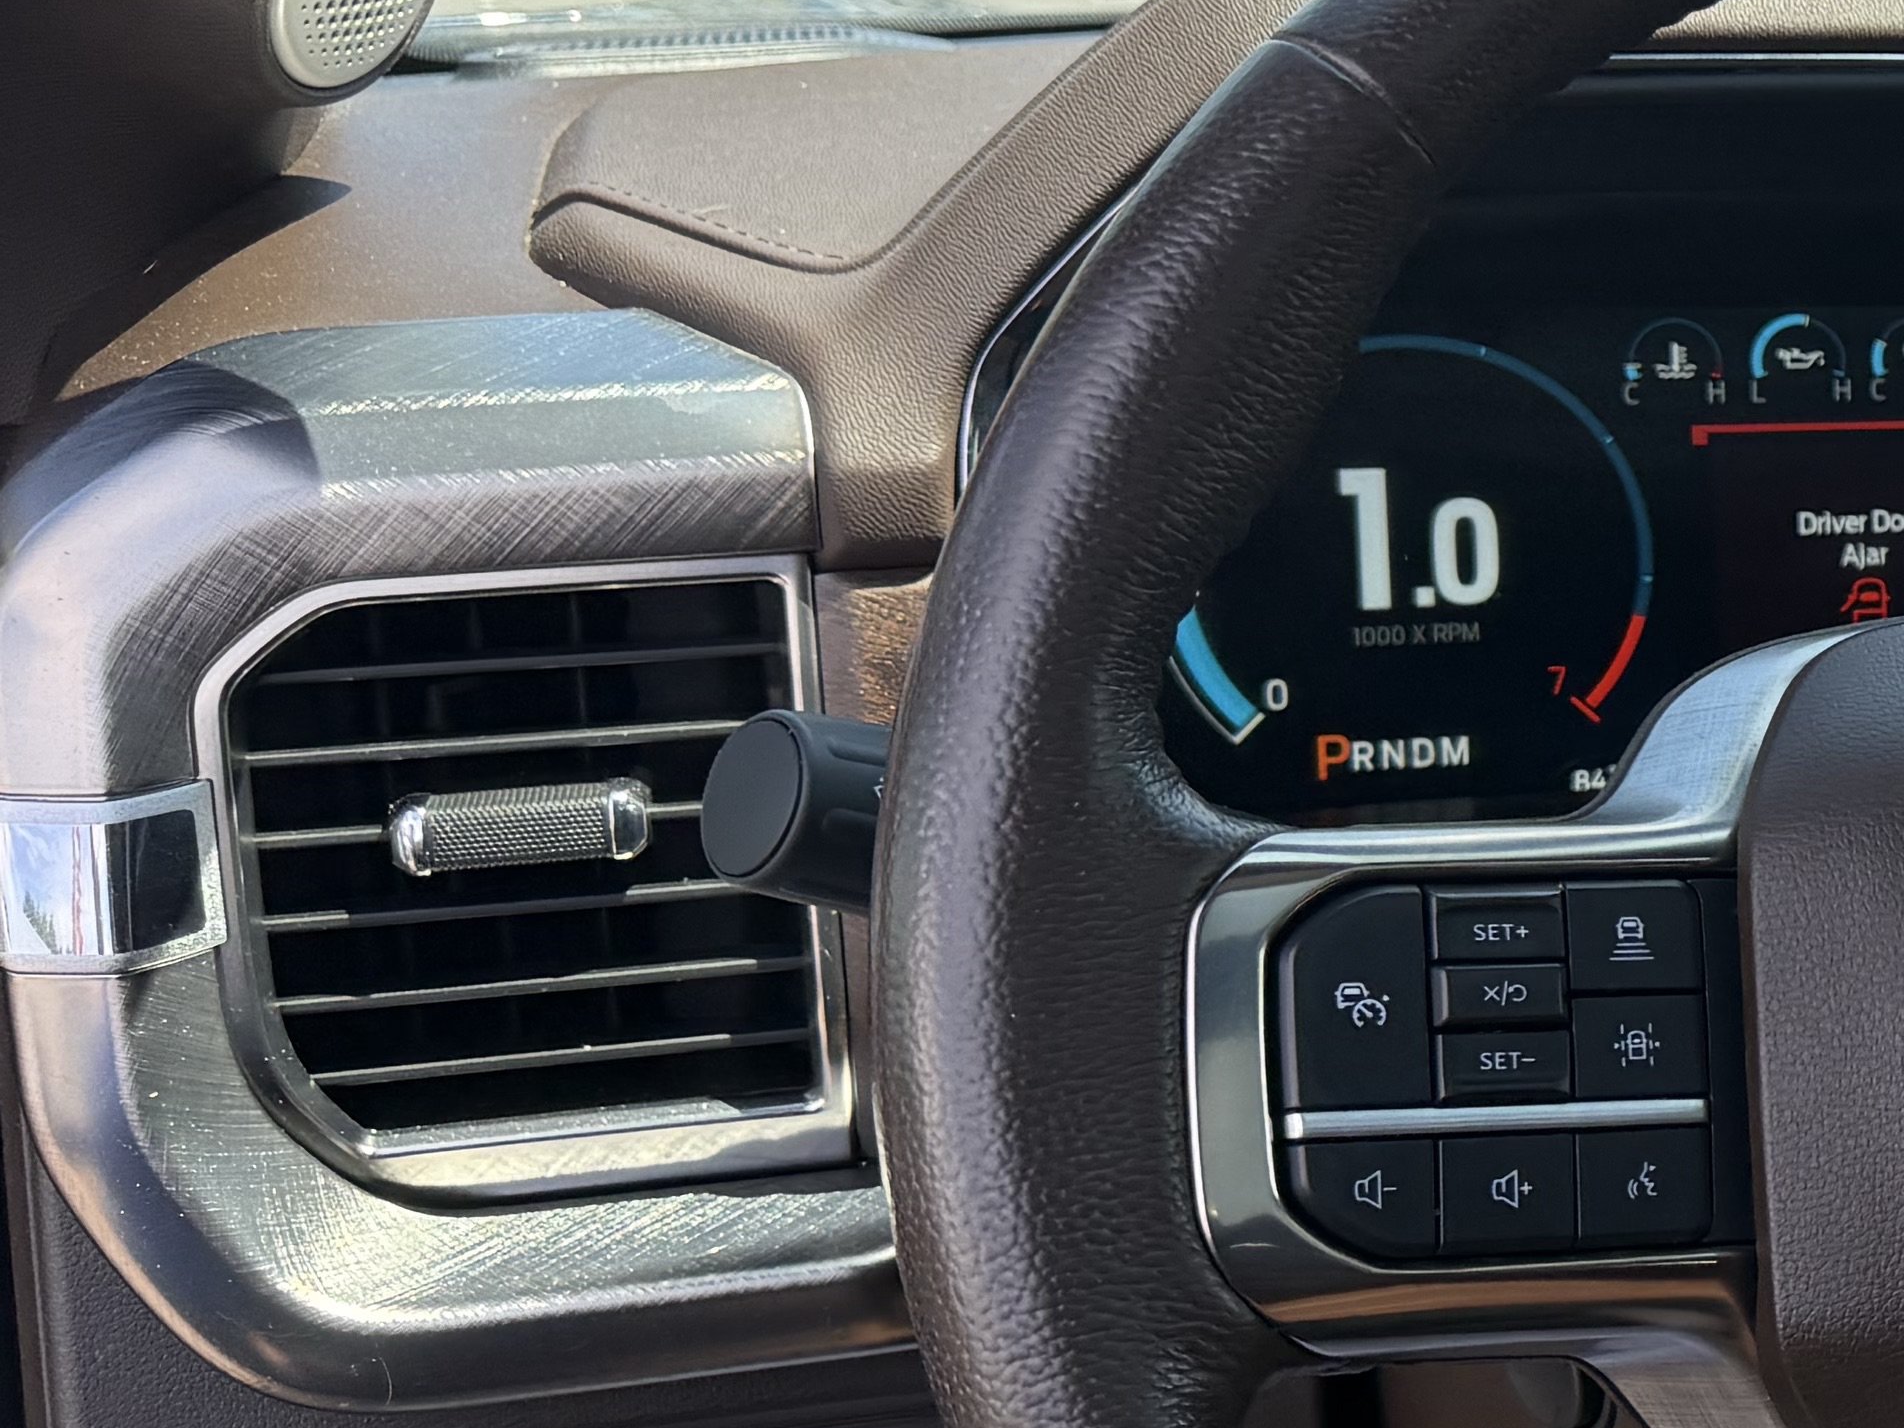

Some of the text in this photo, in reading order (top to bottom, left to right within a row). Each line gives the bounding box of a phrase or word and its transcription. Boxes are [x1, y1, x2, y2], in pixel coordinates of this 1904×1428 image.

[1623, 381, 1640, 405] C
[1708, 380, 1725, 404] H
[1749, 380, 1766, 404] L
[1833, 379, 1851, 402] H
[1869, 378, 1887, 402] C
[1796, 509, 1868, 538] Driver
[1334, 466, 1501, 612] 1.0
[1841, 541, 1889, 570] Ajar
[1352, 624, 1405, 648] 1000
[1432, 622, 1481, 644] RPM
[1547, 666, 1567, 696] 7
[1262, 677, 1289, 712] 0
[1473, 923, 1530, 942] SET+
